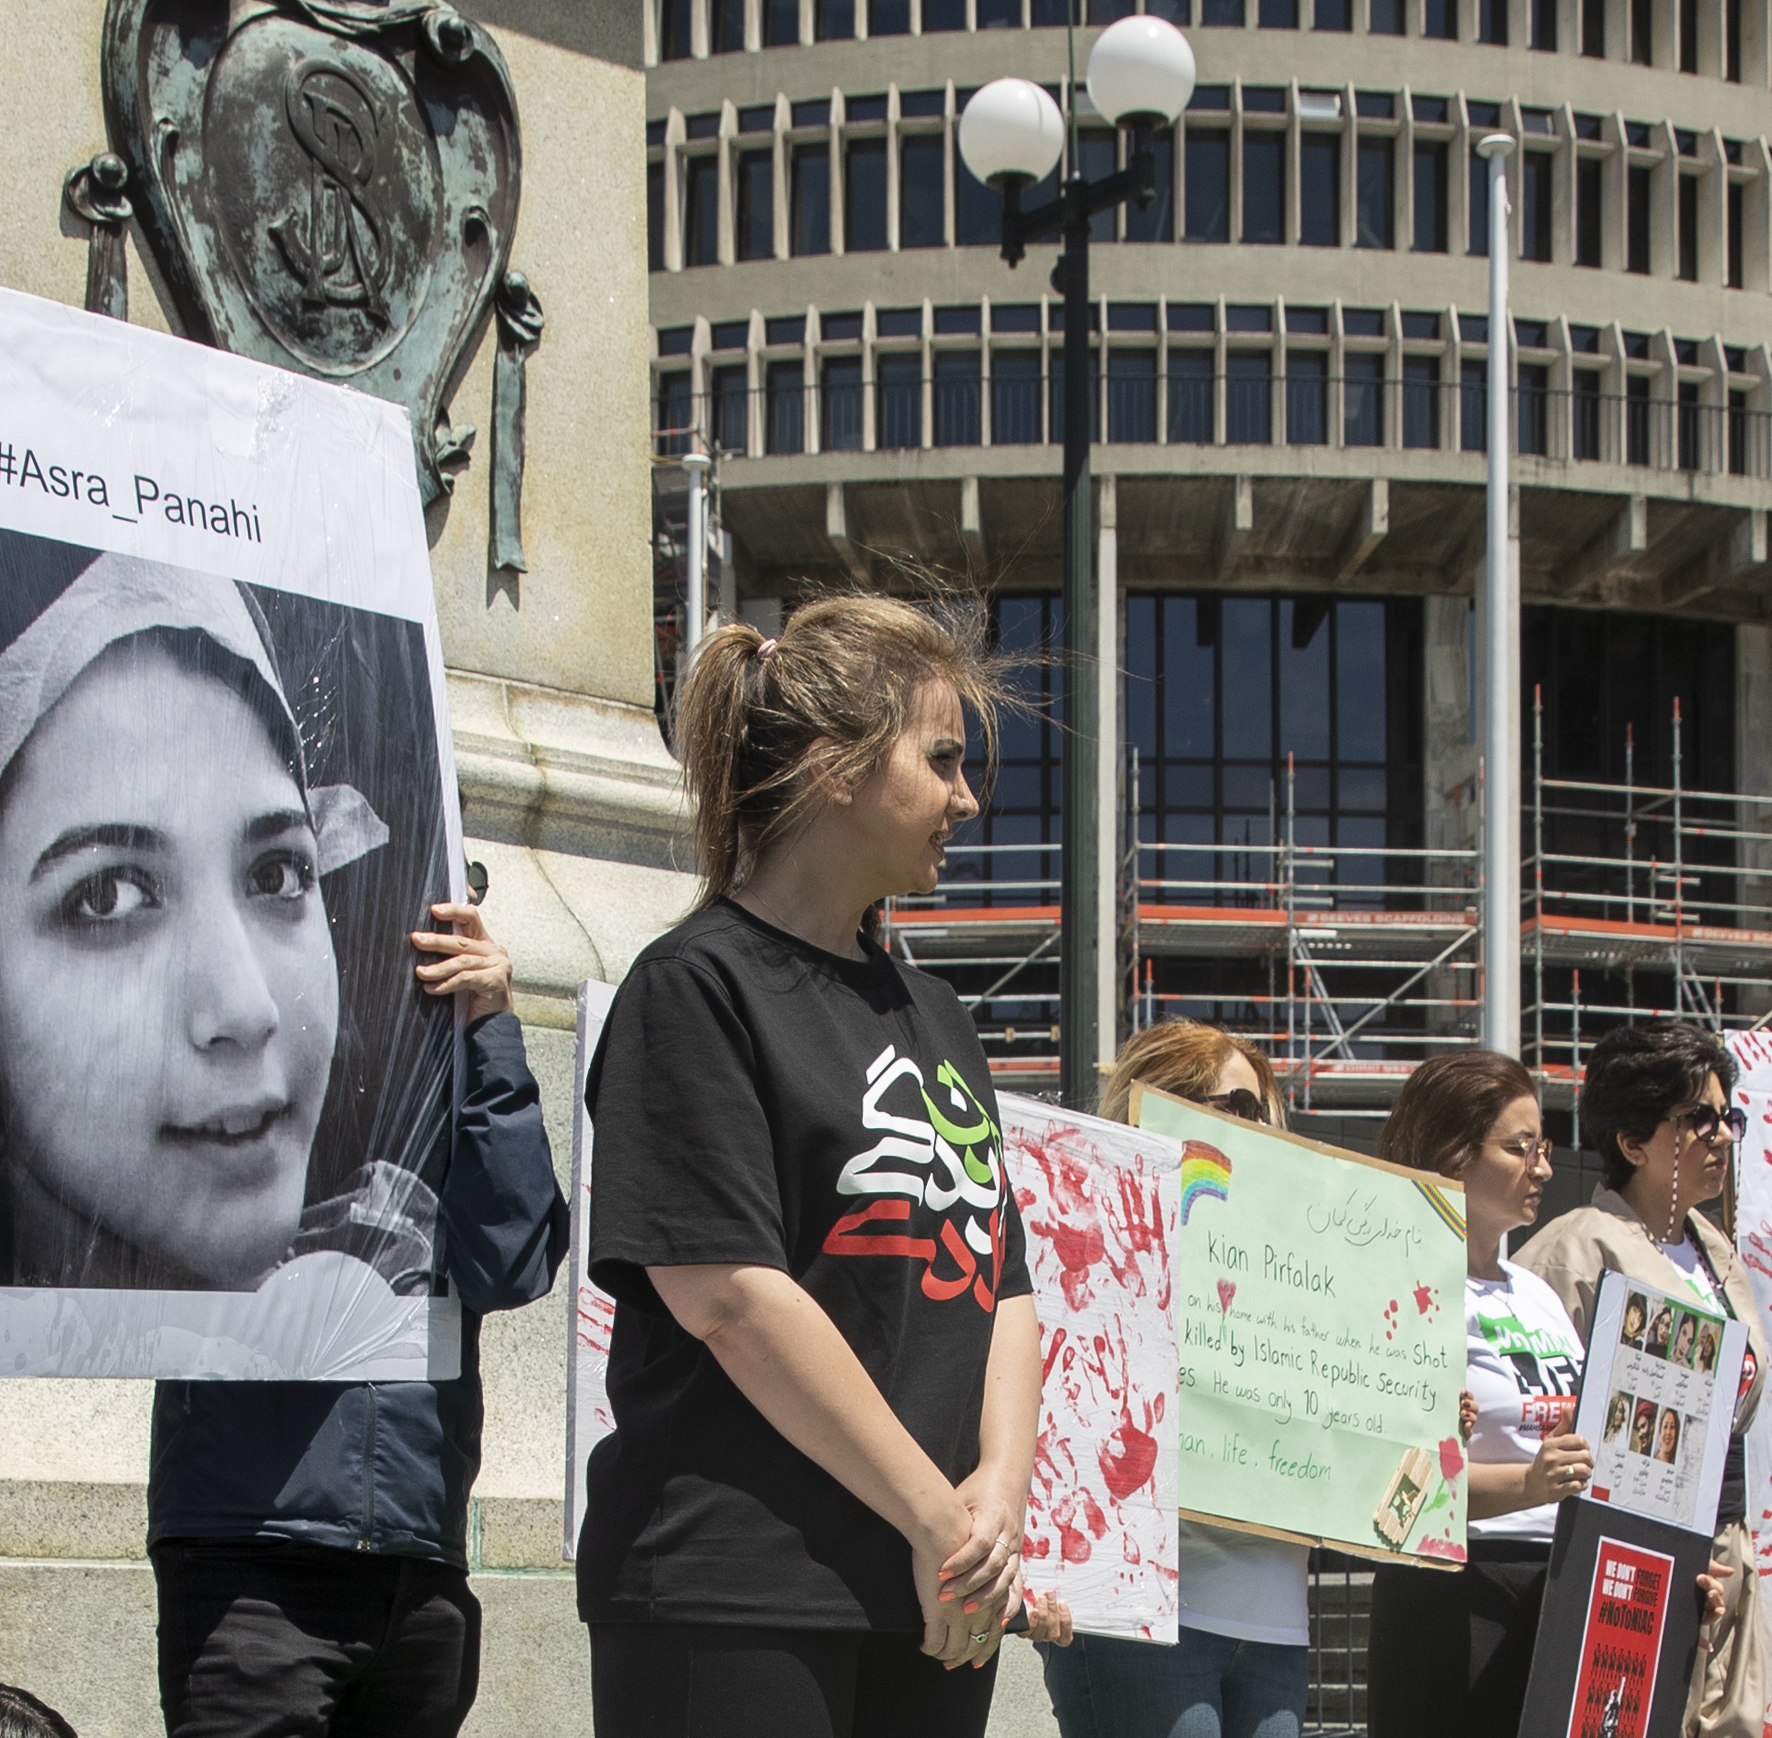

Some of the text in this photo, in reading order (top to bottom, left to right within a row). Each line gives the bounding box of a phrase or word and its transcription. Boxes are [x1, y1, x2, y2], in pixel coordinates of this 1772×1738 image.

[1264, 1243, 1337, 1299] Pirfalak
[1184, 1317, 1437, 1413] killed by Islamic Republic Security
[1230, 1301, 1253, 1323] home
[1256, 1310, 1278, 1329] with
[1283, 1316, 1296, 1334] his
[1335, 1327, 1362, 1350] when
[1368, 1333, 1381, 1356] he
[1385, 1347, 1407, 1361] was
[1412, 1339, 1448, 1369] Shot
[1213, 1370, 1230, 1395] He
[1235, 1383, 1261, 1404] was
[1268, 1388, 1293, 1426] only
[1303, 1388, 1320, 1416] 10
[1321, 1406, 1360, 1430] years
[1365, 1413, 1388, 1435] old.
[1268, 1438, 1332, 1481] freedom
